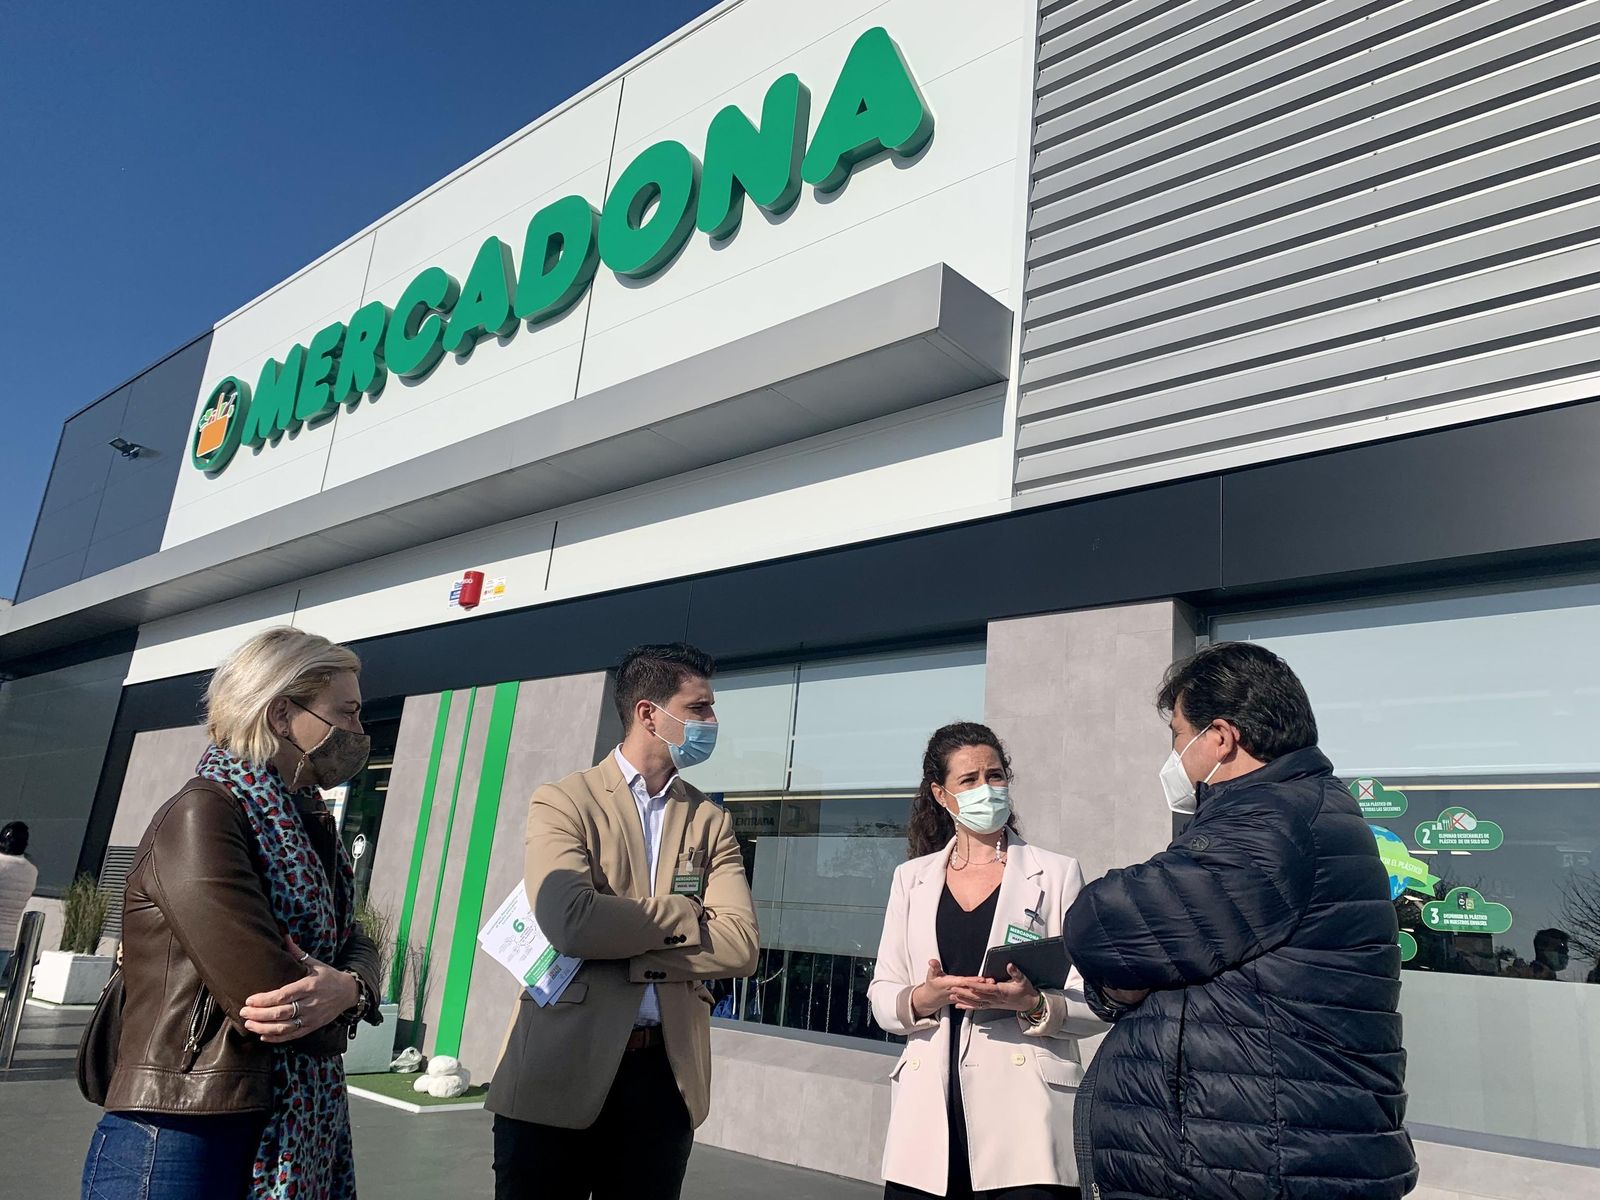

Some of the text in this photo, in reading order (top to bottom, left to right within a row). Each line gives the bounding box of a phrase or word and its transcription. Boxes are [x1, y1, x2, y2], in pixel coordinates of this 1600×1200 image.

[241, 26, 935, 449] MERCADONA
[1422, 828, 1431, 844] 2
[1430, 908, 1440, 924] 3
[512, 918, 525, 933] 6
[1010, 926, 1039, 940] MERCADONA
